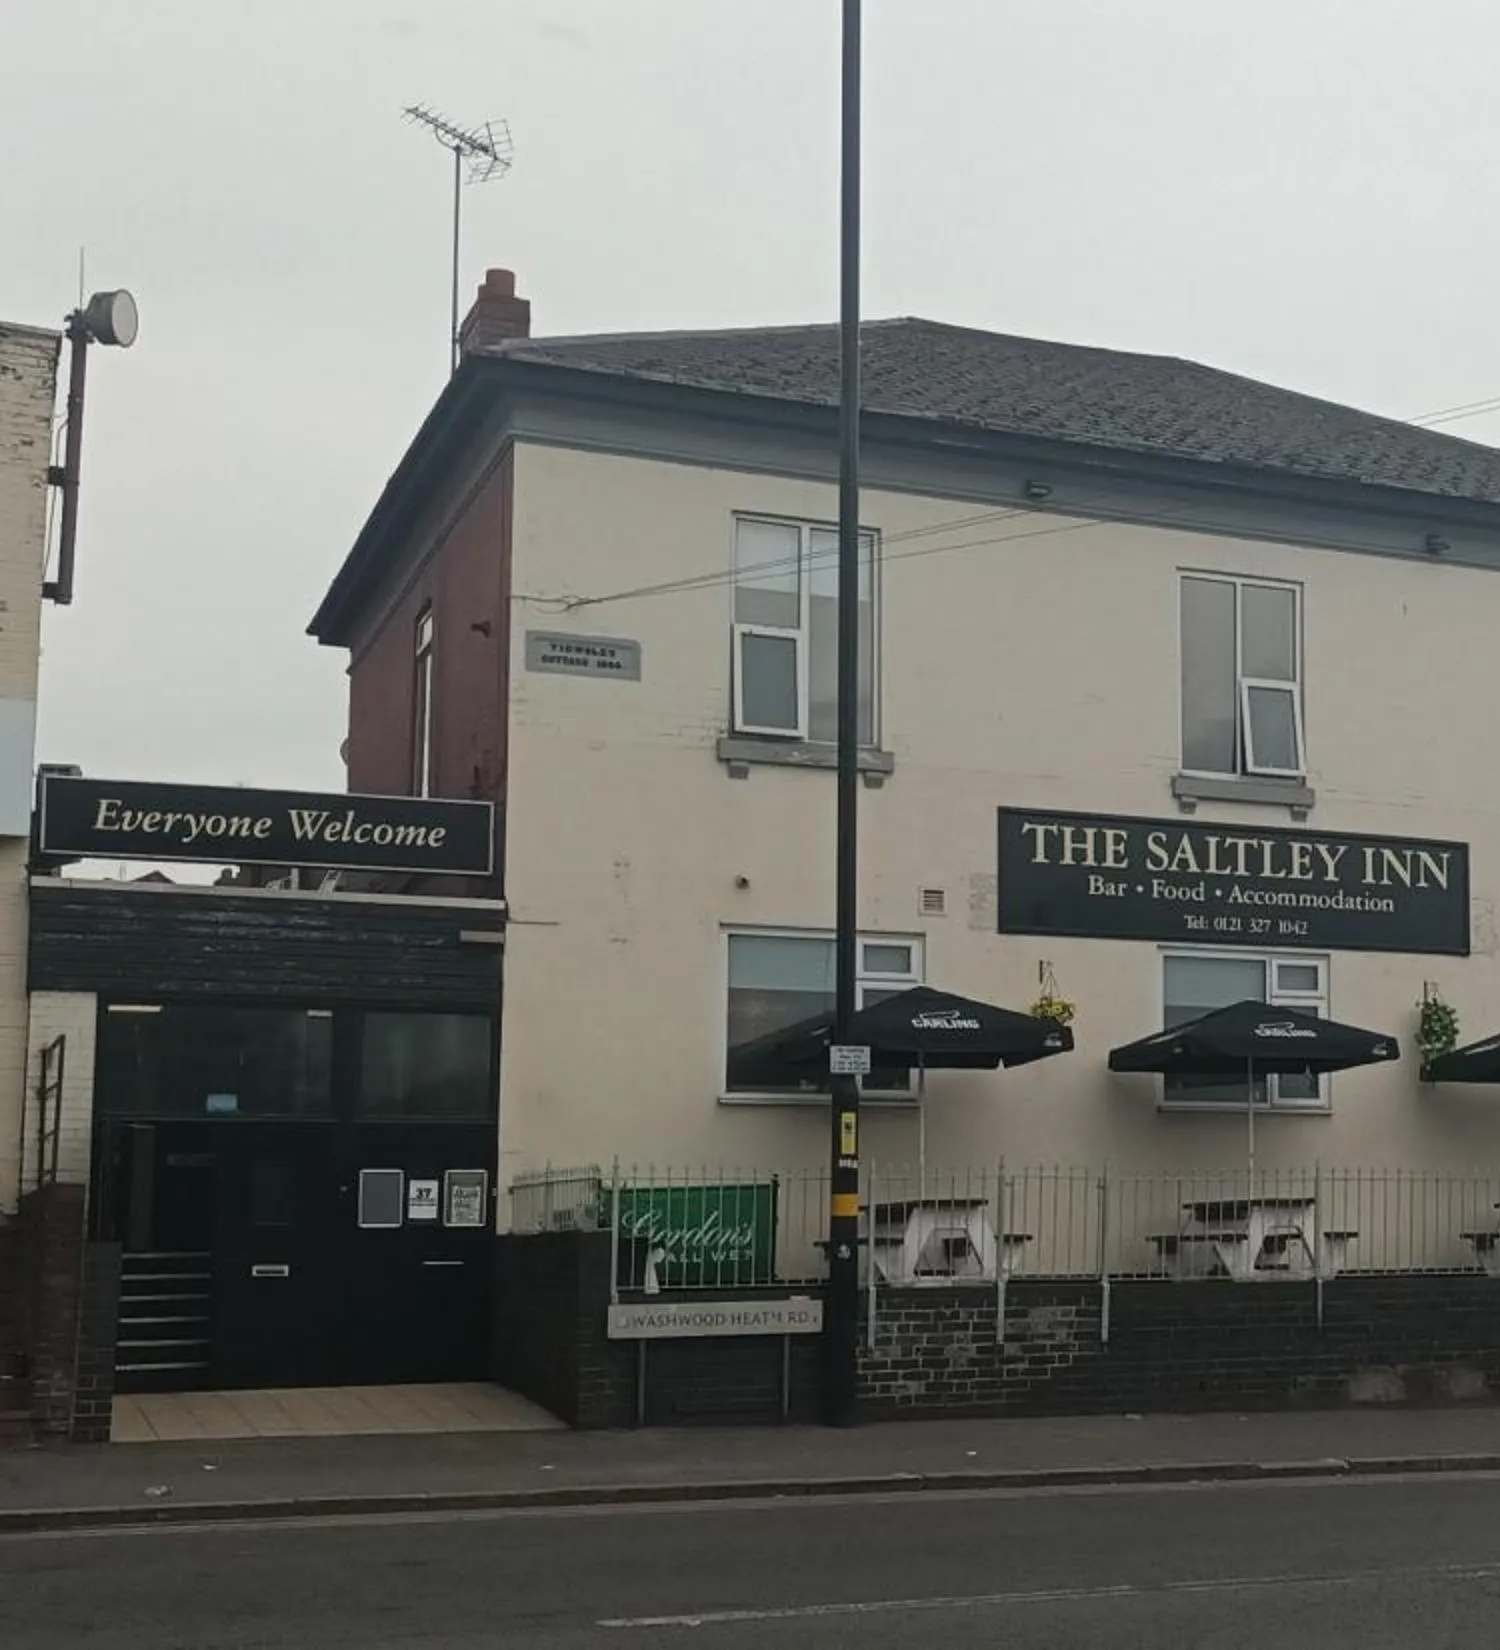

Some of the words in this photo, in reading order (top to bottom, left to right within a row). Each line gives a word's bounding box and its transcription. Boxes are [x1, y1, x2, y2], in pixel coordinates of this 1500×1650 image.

[94, 798, 273, 843] Everyone
[288, 809, 447, 848] Welcome
[1021, 822, 1129, 869] THE
[1145, 831, 1349, 882] SALTLEY
[1361, 847, 1451, 890] INN
[1088, 874, 1127, 897] Bar
[1151, 879, 1205, 902] Food
[1228, 884, 1395, 913] Accommodation
[1183, 915, 1208, 930] Tel:
[1213, 917, 1241, 932] 0121
[1250, 918, 1272, 933] 327
[1279, 920, 1309, 935] 1042
[632, 1311, 725, 1329] WASHWOOD
[787, 1310, 809, 1324] RD
